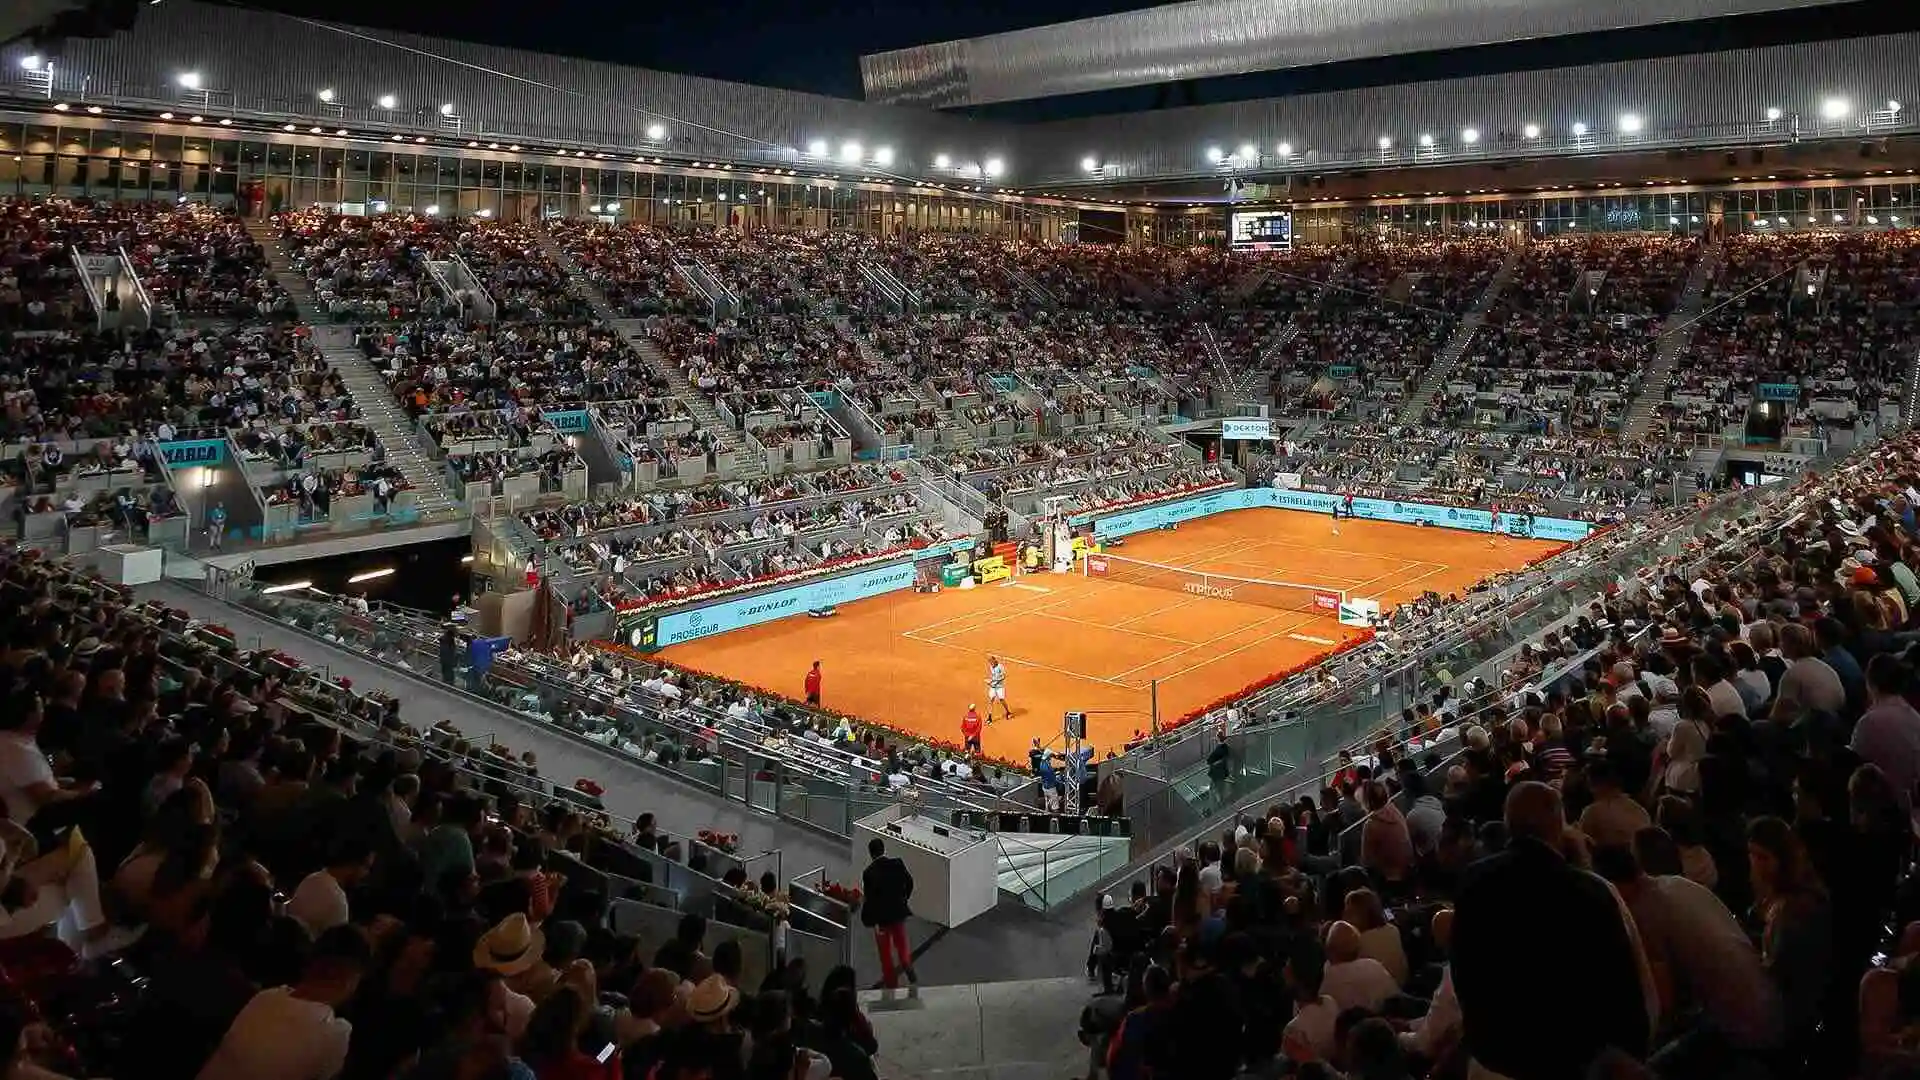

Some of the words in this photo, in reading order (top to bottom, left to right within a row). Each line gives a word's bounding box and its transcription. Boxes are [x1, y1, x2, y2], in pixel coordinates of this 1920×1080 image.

[1233, 424, 1269, 432] DEKTON
[1279, 495, 1312, 507] ESTRELLA
[867, 571, 909, 588] DUNLOP
[748, 598, 798, 616] DUNLOP
[670, 623, 719, 642] PROSEGUR
